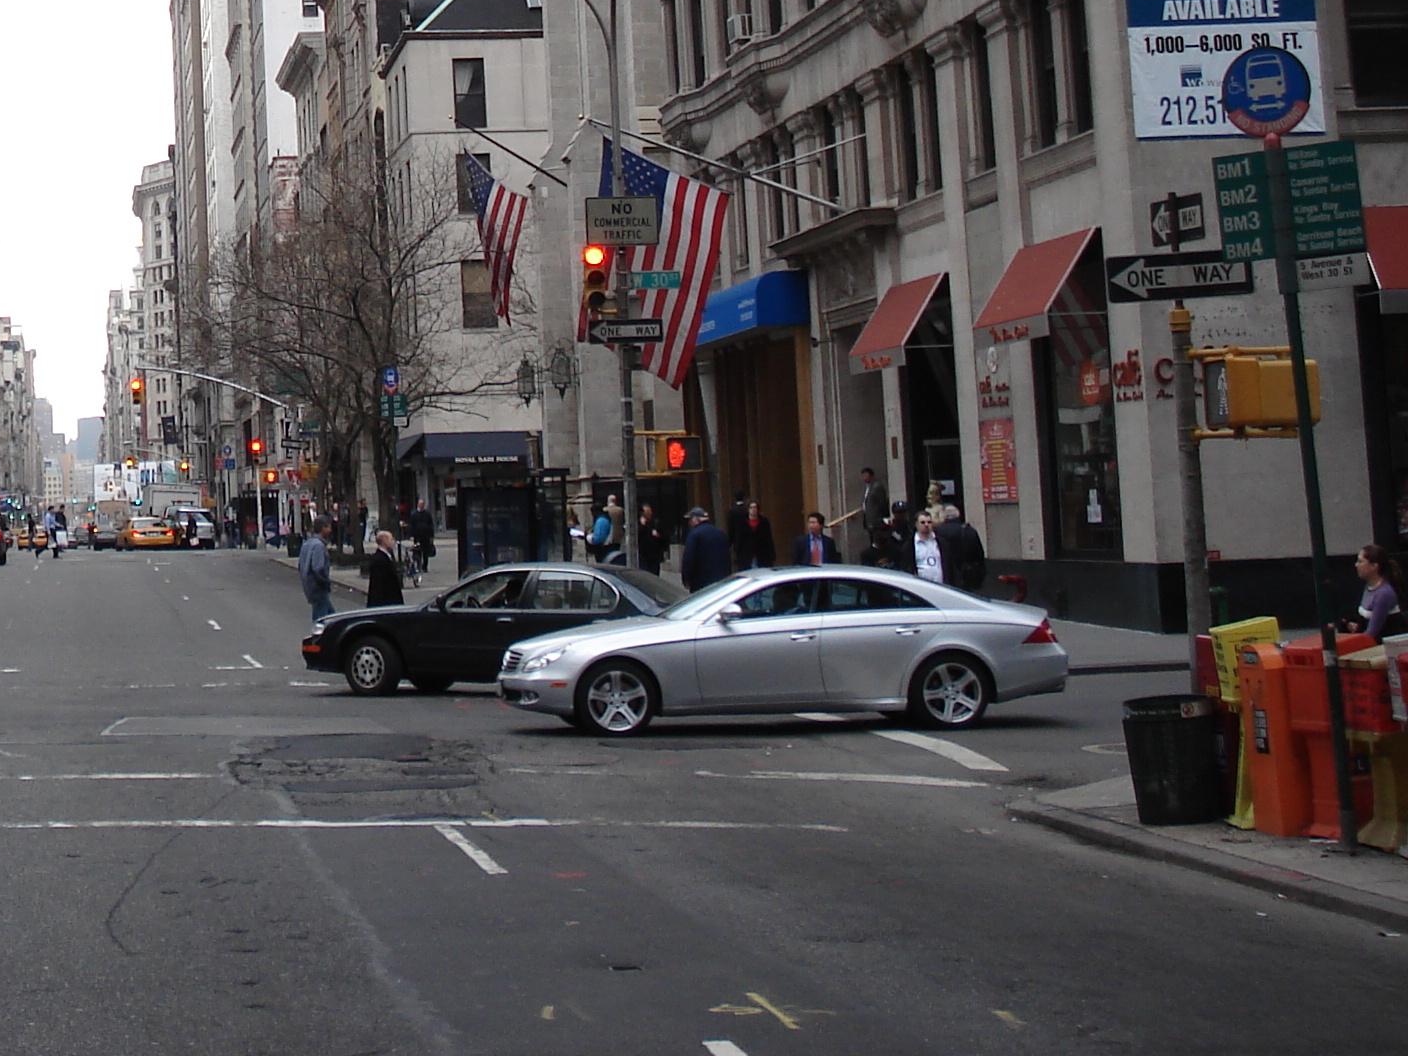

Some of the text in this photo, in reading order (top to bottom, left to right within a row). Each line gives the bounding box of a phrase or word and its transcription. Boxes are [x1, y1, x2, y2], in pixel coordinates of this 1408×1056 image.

[1282, 32, 1302, 50] FT.
[1235, 108, 1304, 132] NO STANDING
[1327, 155, 1354, 165] Service
[1217, 157, 1251, 180] BM1
[1220, 184, 1258, 206] BM2
[611, 203, 632, 215] NO
[1322, 202, 1339, 213] Bay
[594, 217, 652, 228] COMMERCIAL
[1157, 208, 1197, 232] ON WAY
[1223, 211, 1260, 232] BM3
[603, 229, 642, 240] TRAFFIC
[1337, 226, 1362, 237] Beach
[1226, 238, 1263, 259] BM4
[1300, 256, 1353, 271] 5 Avenue &
[633, 275, 643, 288] W
[651, 274, 667, 288] 30
[1127, 263, 1233, 288] ONE WAY
[1301, 266, 1353, 281] West 30 St
[600, 325, 657, 337] ONE WAY
